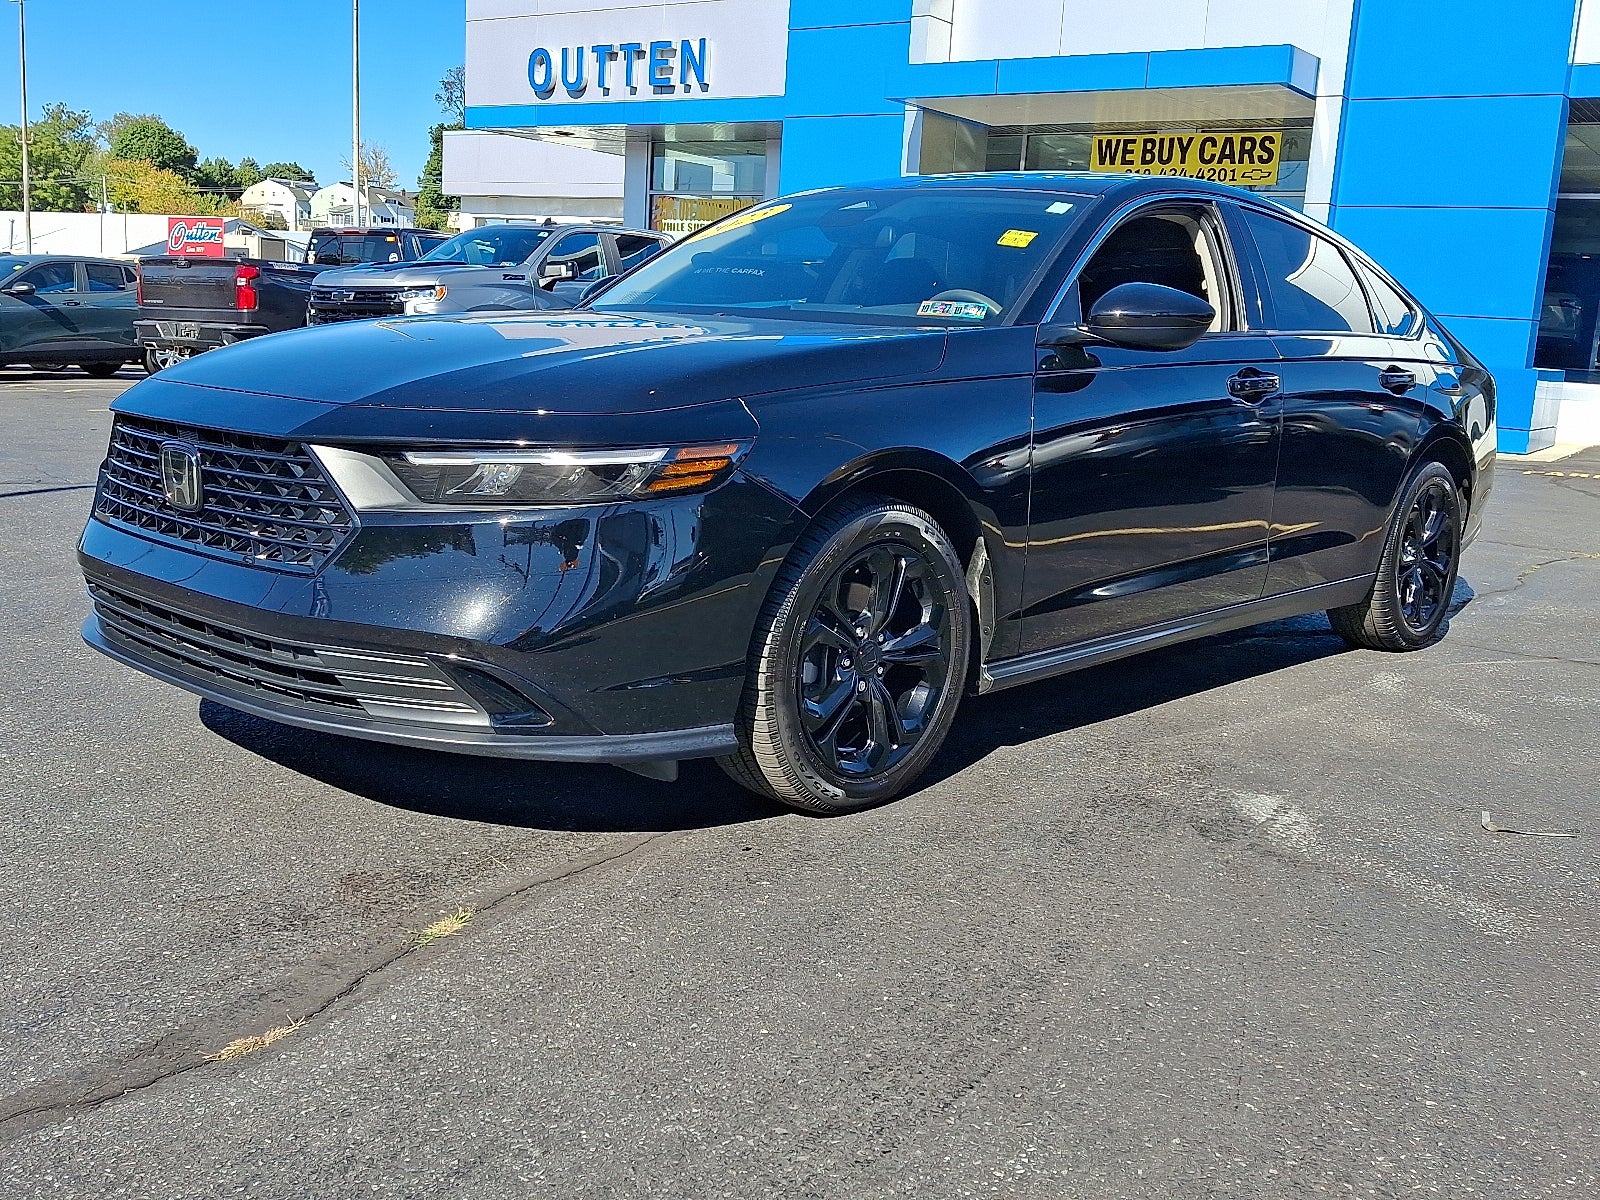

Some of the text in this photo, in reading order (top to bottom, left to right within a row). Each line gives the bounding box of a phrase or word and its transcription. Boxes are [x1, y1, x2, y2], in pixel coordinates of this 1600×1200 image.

[527, 37, 711, 98] OUTTEN
[1097, 135, 1276, 166] WE BUY CARS
[170, 221, 222, 250] Outten
[730, 267, 766, 277] CARFAX
